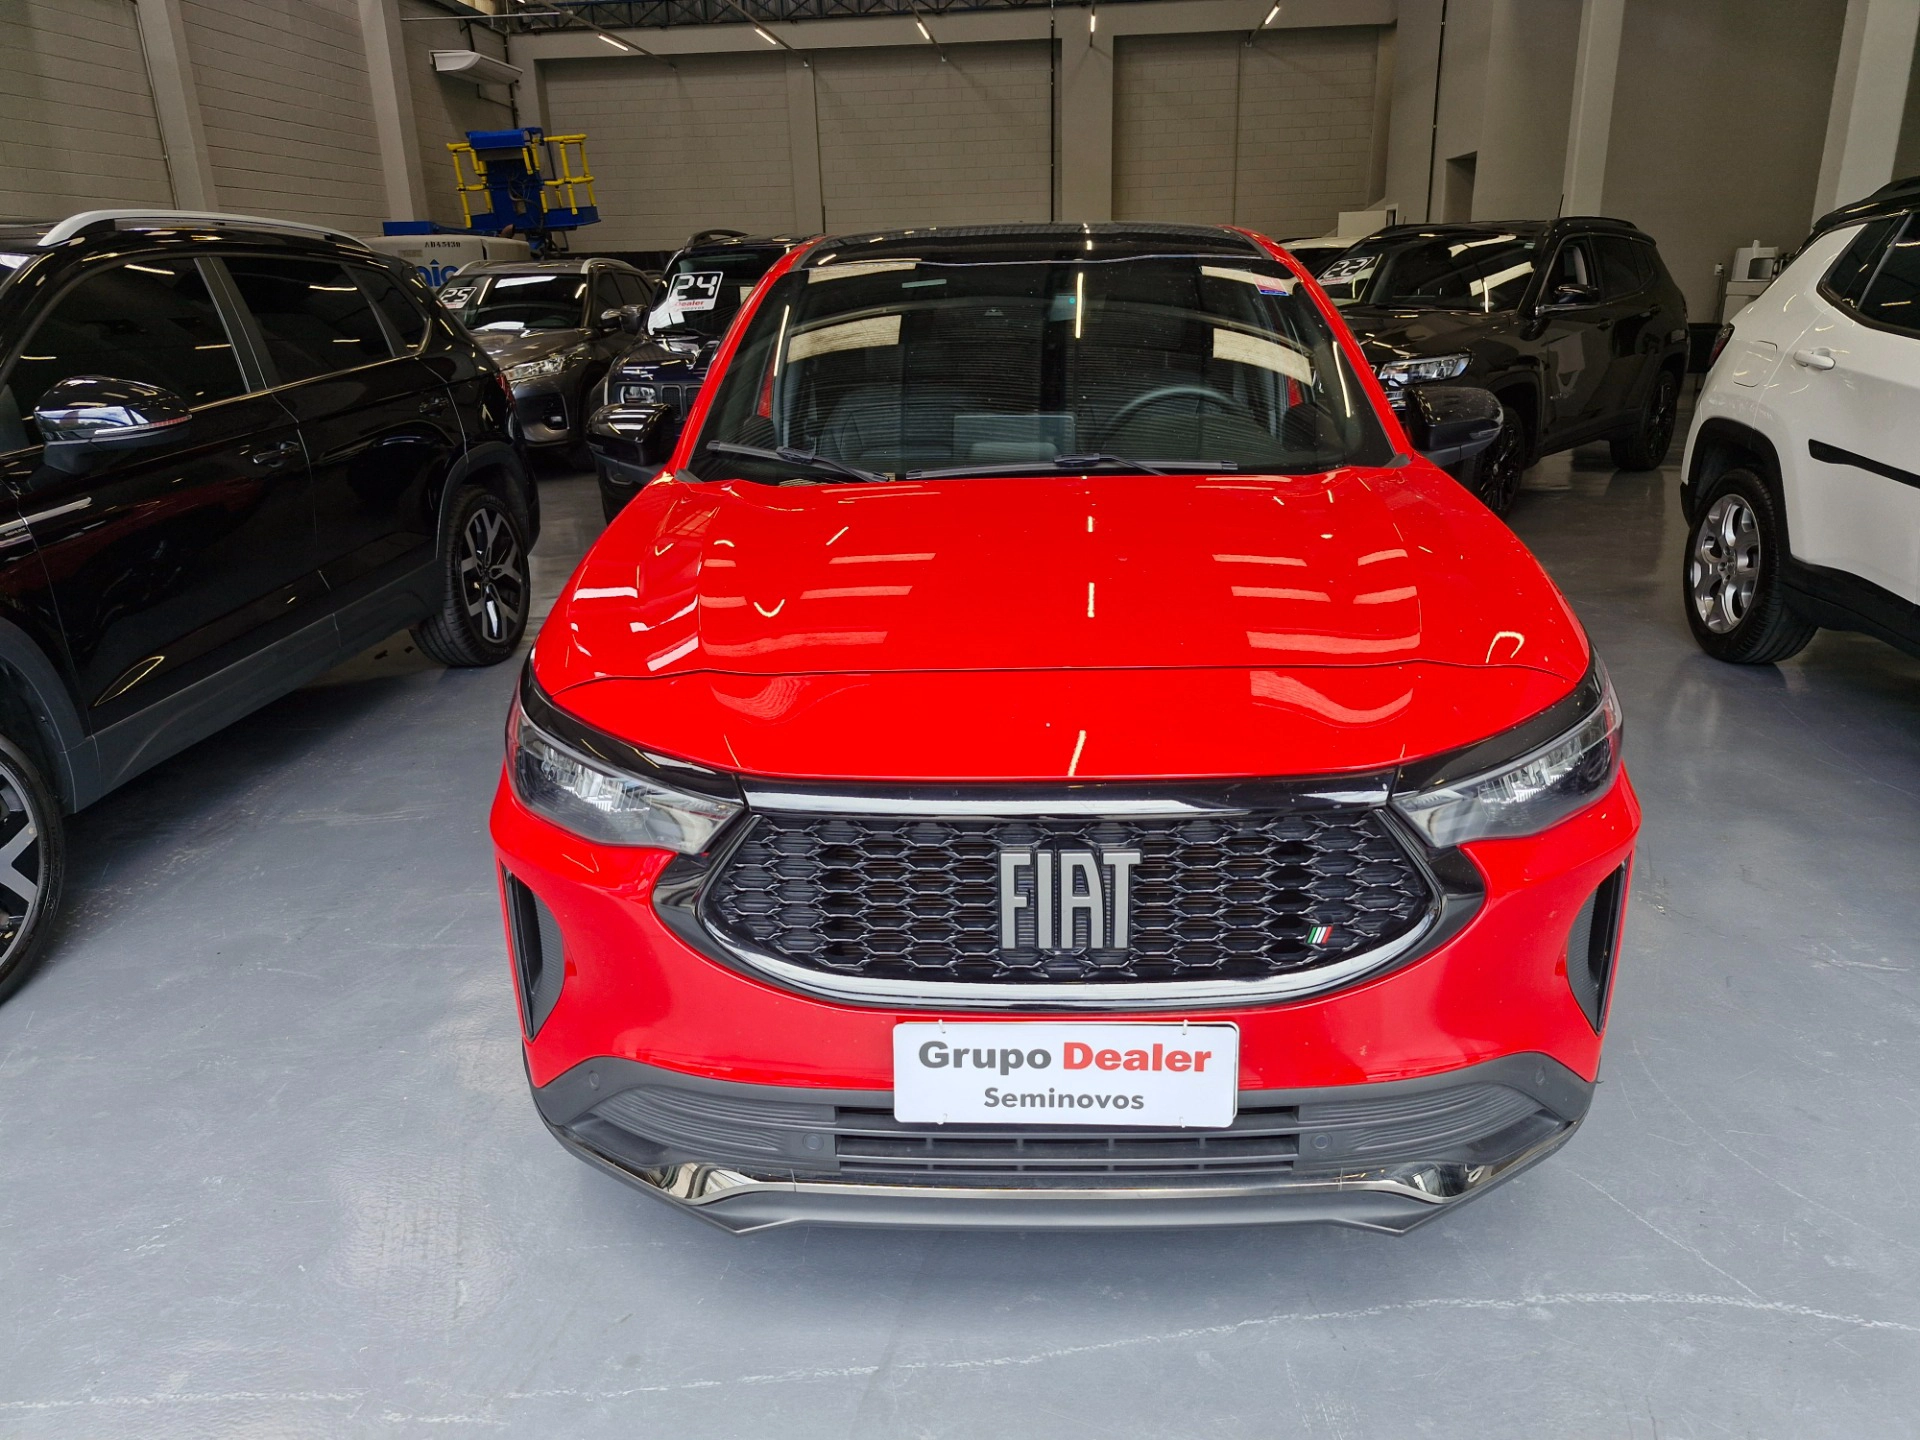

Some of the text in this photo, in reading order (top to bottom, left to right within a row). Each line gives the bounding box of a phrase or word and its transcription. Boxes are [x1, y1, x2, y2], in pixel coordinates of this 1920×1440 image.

[1323, 259, 1368, 279] 22
[440, 289, 471, 303] 25
[673, 275, 718, 299] 24
[999, 851, 1142, 949] FIAT
[918, 1040, 1212, 1075] Grupo Dealer
[983, 1087, 1145, 1110] Seminovos
